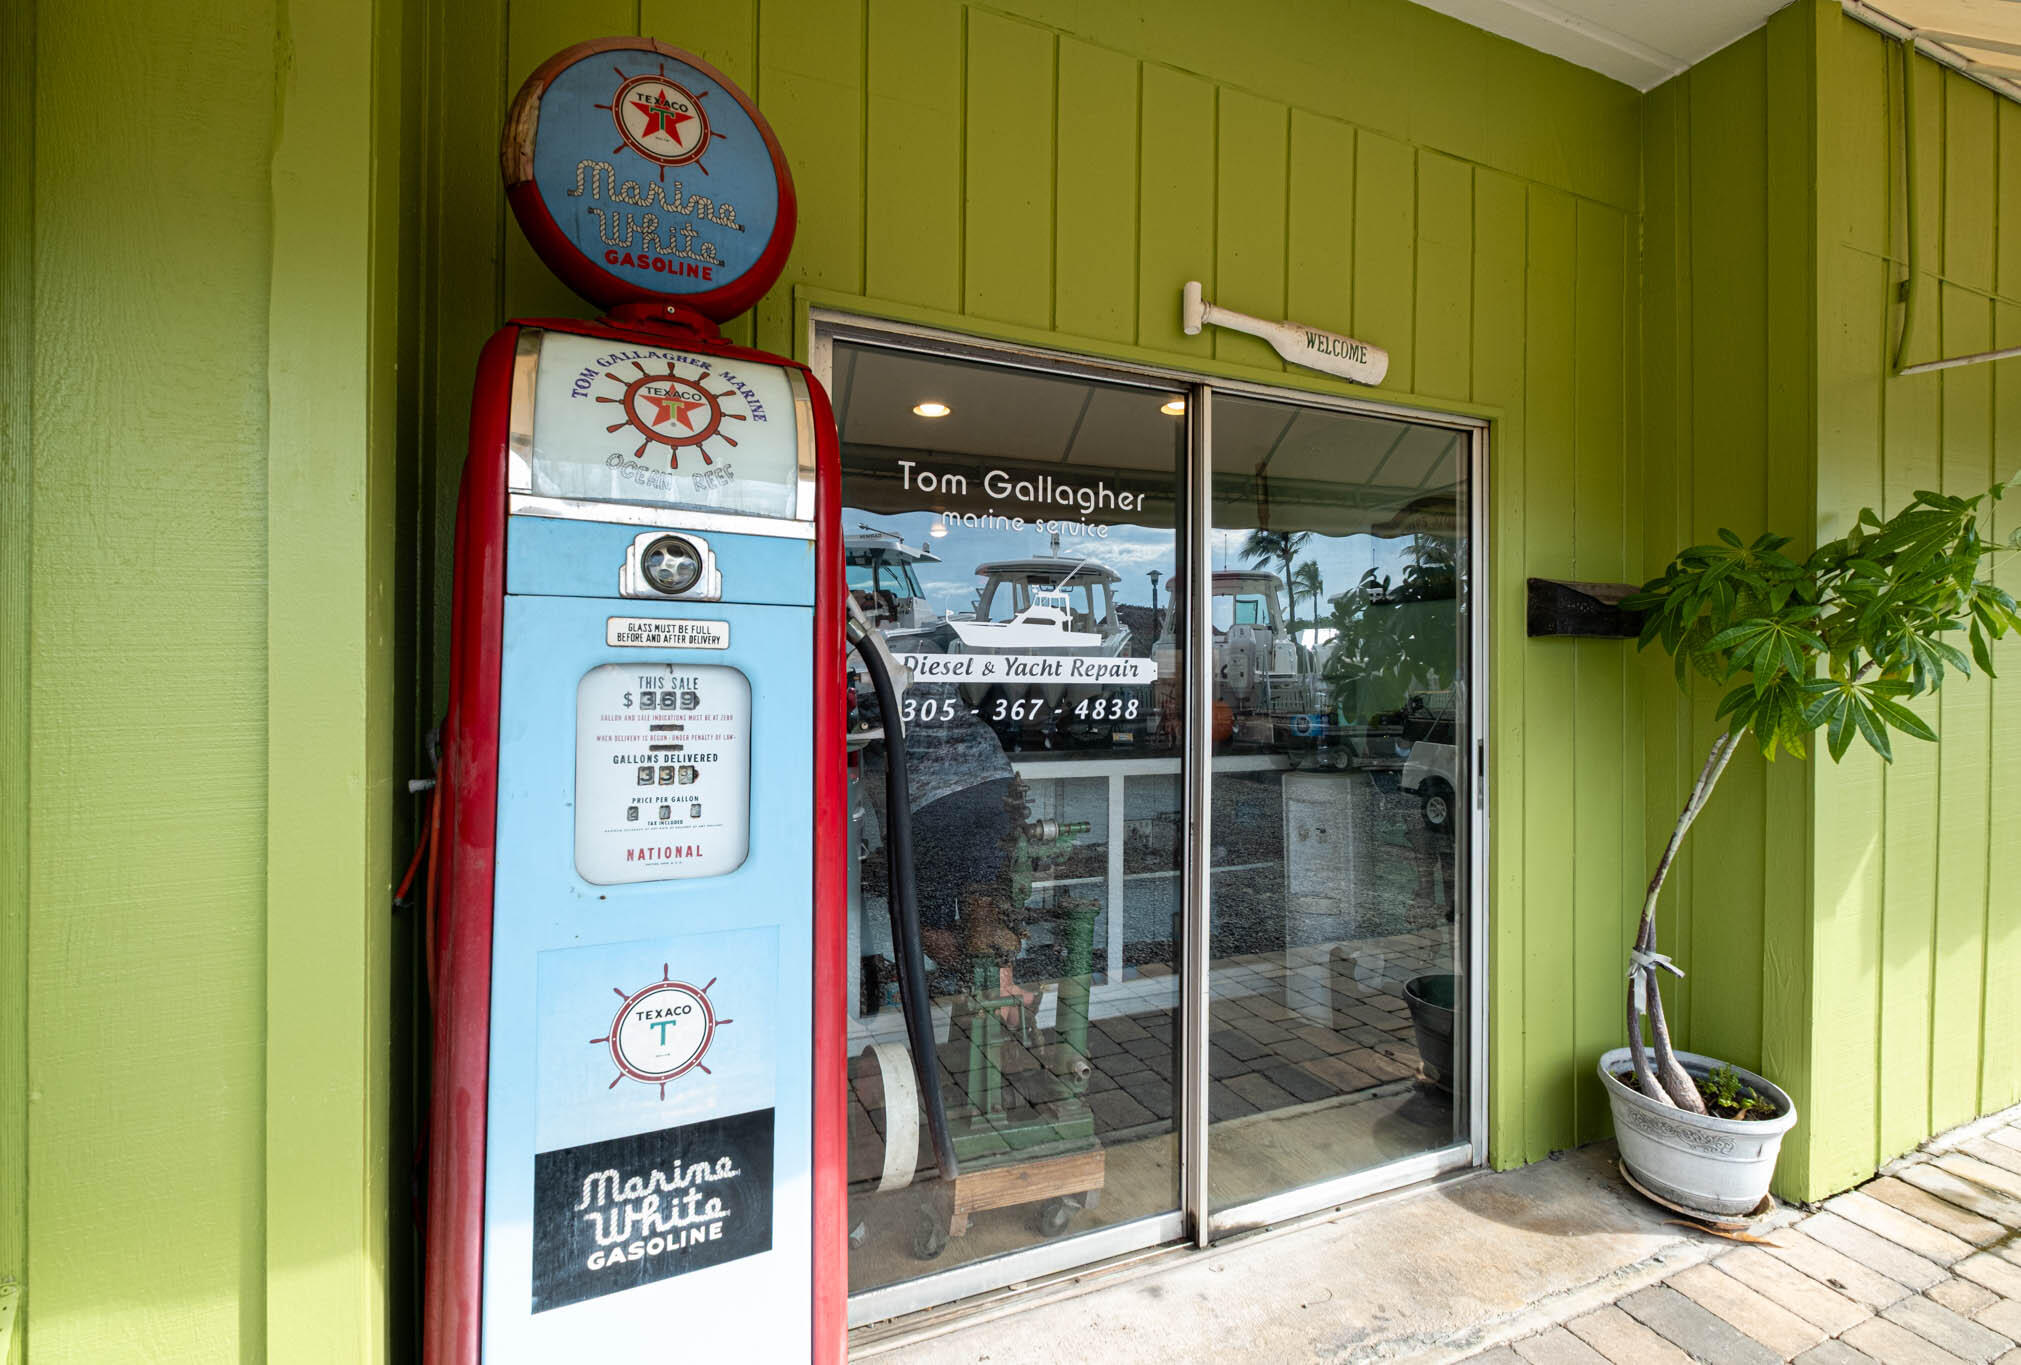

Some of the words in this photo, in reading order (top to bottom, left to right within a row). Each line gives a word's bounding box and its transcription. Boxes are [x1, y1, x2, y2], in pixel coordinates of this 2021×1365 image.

[636, 91, 689, 114] TEXACO
[567, 159, 745, 232] Marine
[587, 208, 726, 267] White
[604, 249, 713, 281] GASOLINE
[1305, 331, 1368, 365] WELCOME
[571, 367, 600, 400] TOM
[596, 350, 713, 372] GALLAGHER
[718, 370, 768, 424] MARINE
[645, 386, 702, 402] TEXACO
[898, 460, 968, 495] Tom
[983, 470, 1145, 514] Gallagher
[941, 509, 1025, 532] marine
[1035, 517, 1110, 539] service
[617, 632, 644, 643] BEFORE
[646, 634, 662, 644] AND
[663, 634, 687, 644] AFTER
[688, 635, 720, 644] DELIVERY
[628, 623, 652, 632] GLASS
[654, 624, 677, 634] MUST
[678, 625, 689, 634] BE
[691, 626, 711, 635] FULL
[903, 655, 974, 677] Diesel
[982, 660, 995, 676] &
[1004, 657, 1063, 678] Yacht
[1070, 659, 1140, 682] Repair
[638, 676, 665, 689] THIS
[671, 677, 699, 690] SALE
[623, 691, 633, 709] $
[901, 699, 957, 722] 305
[992, 699, 1044, 721] 367
[1074, 699, 1139, 720] 4838
[613, 754, 659, 764] GALLONS
[664, 754, 718, 763] DELIVERED
[626, 845, 703, 862] NATIONAL
[636, 1005, 692, 1022] TEXACO
[574, 1156, 741, 1212] Marine
[584, 1187, 731, 1246] White
[587, 1221, 723, 1271] GASOLINE
